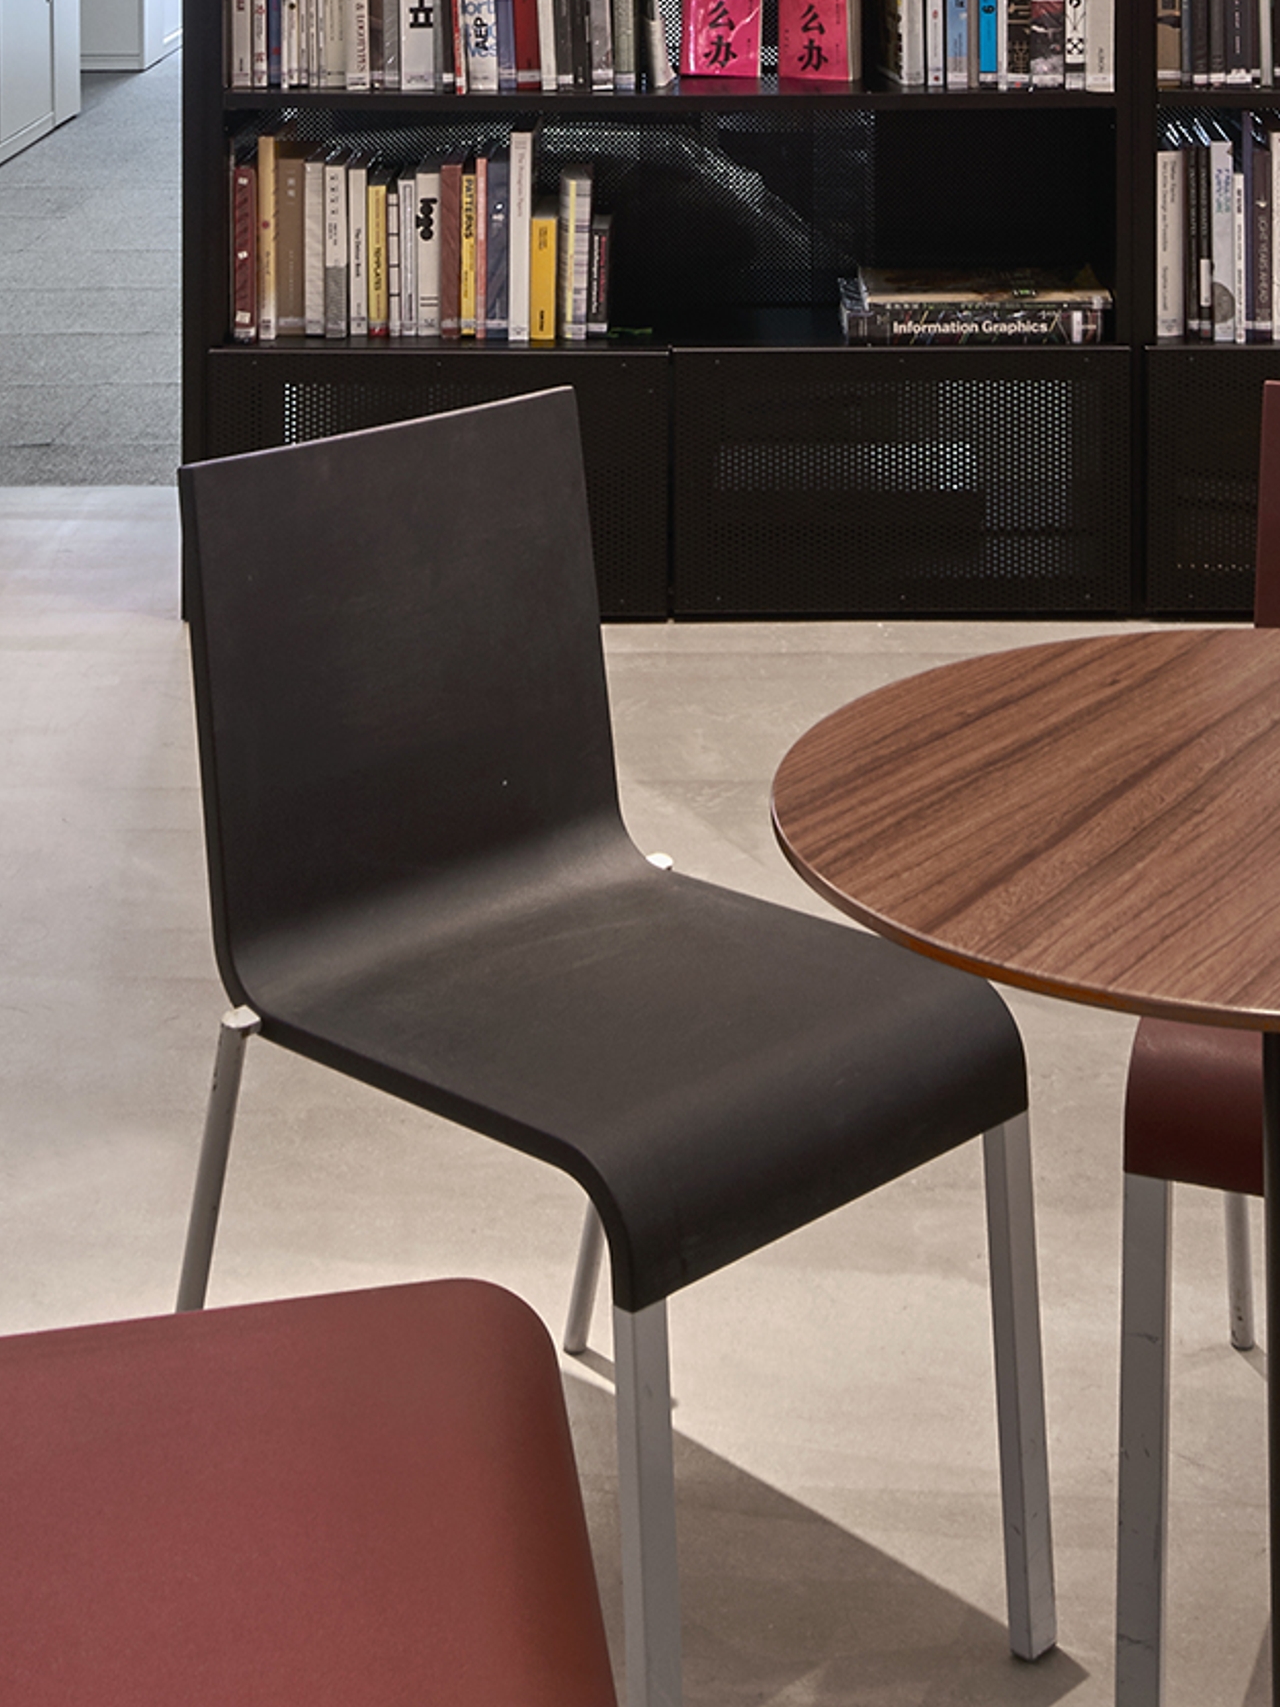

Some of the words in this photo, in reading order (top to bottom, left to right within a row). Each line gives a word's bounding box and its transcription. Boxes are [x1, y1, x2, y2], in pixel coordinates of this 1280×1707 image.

[982, 4, 995, 15] 9
[354, 14, 366, 73] LOGOTYPES
[474, 16, 489, 52] AEP
[415, 197, 439, 242] logo
[463, 177, 475, 240] PATTERNS
[1258, 215, 1268, 241] LIGHT
[373, 246, 382, 291] TEMPLATES
[1258, 243, 1268, 270] YEARS
[1258, 273, 1268, 304] AHEAD
[892, 319, 980, 335] Information
[980, 319, 1048, 338] Graphics
